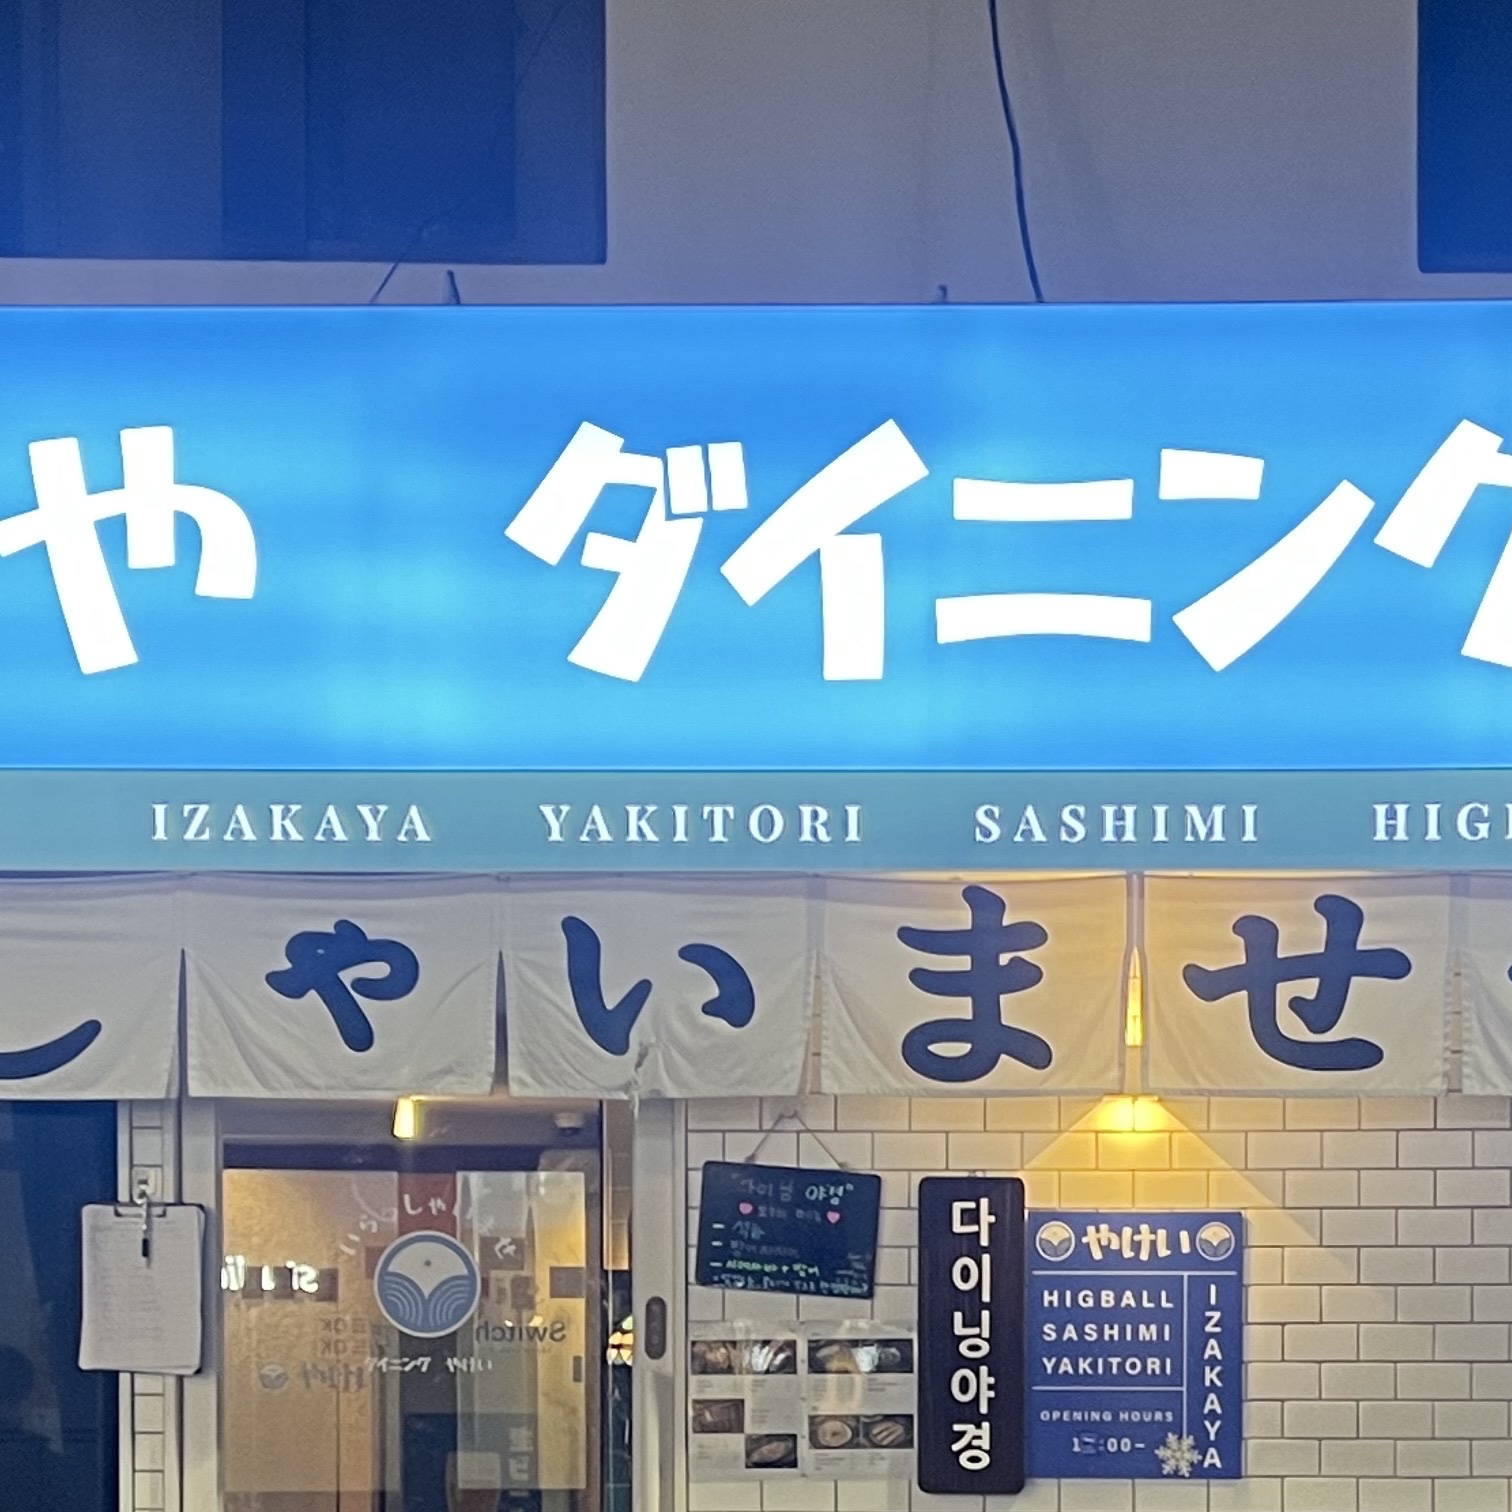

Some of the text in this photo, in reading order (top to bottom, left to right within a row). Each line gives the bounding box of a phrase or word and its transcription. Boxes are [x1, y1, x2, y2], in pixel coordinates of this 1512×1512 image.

[0, 425, 258, 675] や
[151, 802, 432, 843] IZAKAYA
[539, 802, 863, 843] YAKITORI
[973, 803, 1261, 843] SASHIMI
[1081, 1222, 1191, 1261] やけい
[1042, 1289, 1175, 1309] HIGBALL
[950, 1196, 997, 1472] 다이닝야경
[1042, 1323, 1171, 1342] SASHIMI
[1041, 1357, 1171, 1376] YAKITORI
[1202, 1283, 1224, 1469] IZAKAYA
[1040, 1410, 1174, 1423] OPENING HOURS
